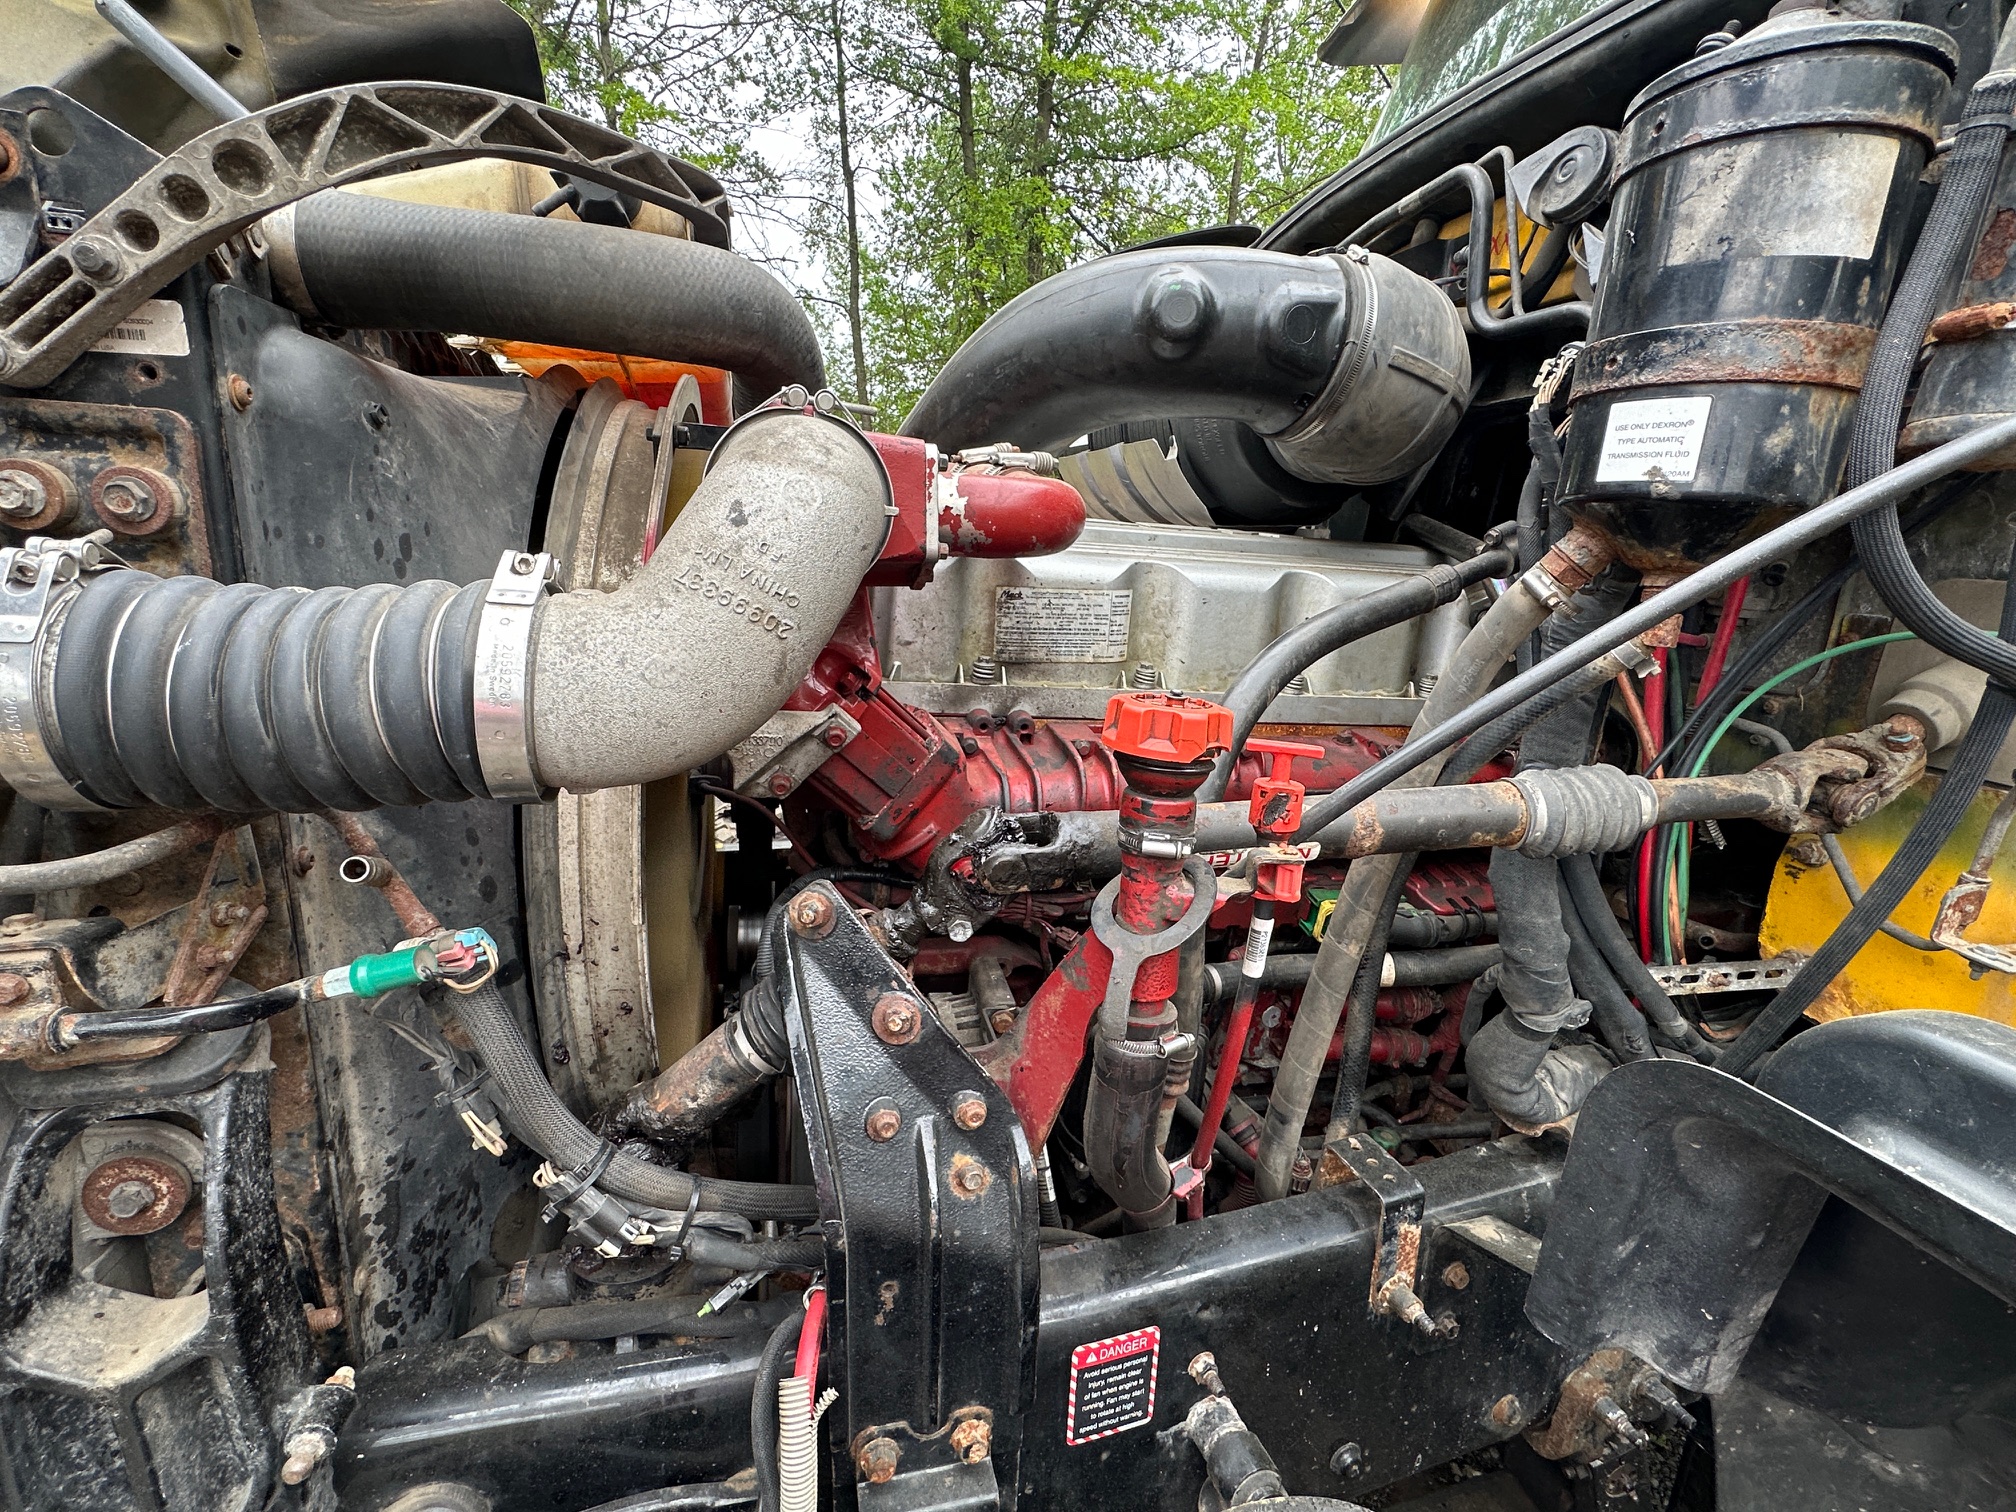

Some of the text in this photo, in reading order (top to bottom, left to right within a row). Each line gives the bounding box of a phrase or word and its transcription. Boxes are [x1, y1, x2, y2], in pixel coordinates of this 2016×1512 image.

[1615, 424, 1629, 432] USE
[1630, 422, 1651, 430] ONLY
[1617, 436, 1685, 445] TYPE AUTOMATIC
[1607, 450, 1690, 459] TRANSMISSION FLUID
[740, 562, 801, 609] CHINA
[673, 566, 794, 640] 20999337
[1100, 1337, 1148, 1360] DANGER
[1083, 1355, 1149, 1380] Avoid serious personal
[1106, 1373, 1127, 1383] remain
[1127, 1368, 1142, 1378] clear
[1083, 1378, 1144, 1401] of fan when engine is
[1081, 1388, 1146, 1412] running. Fan may start
[1097, 1407, 1115, 1418] rotate
[1115, 1405, 1122, 1413] at
[1122, 1401, 1135, 1411] high
[1079, 1422, 1098, 1434] speed
[1098, 1416, 1120, 1428] without
